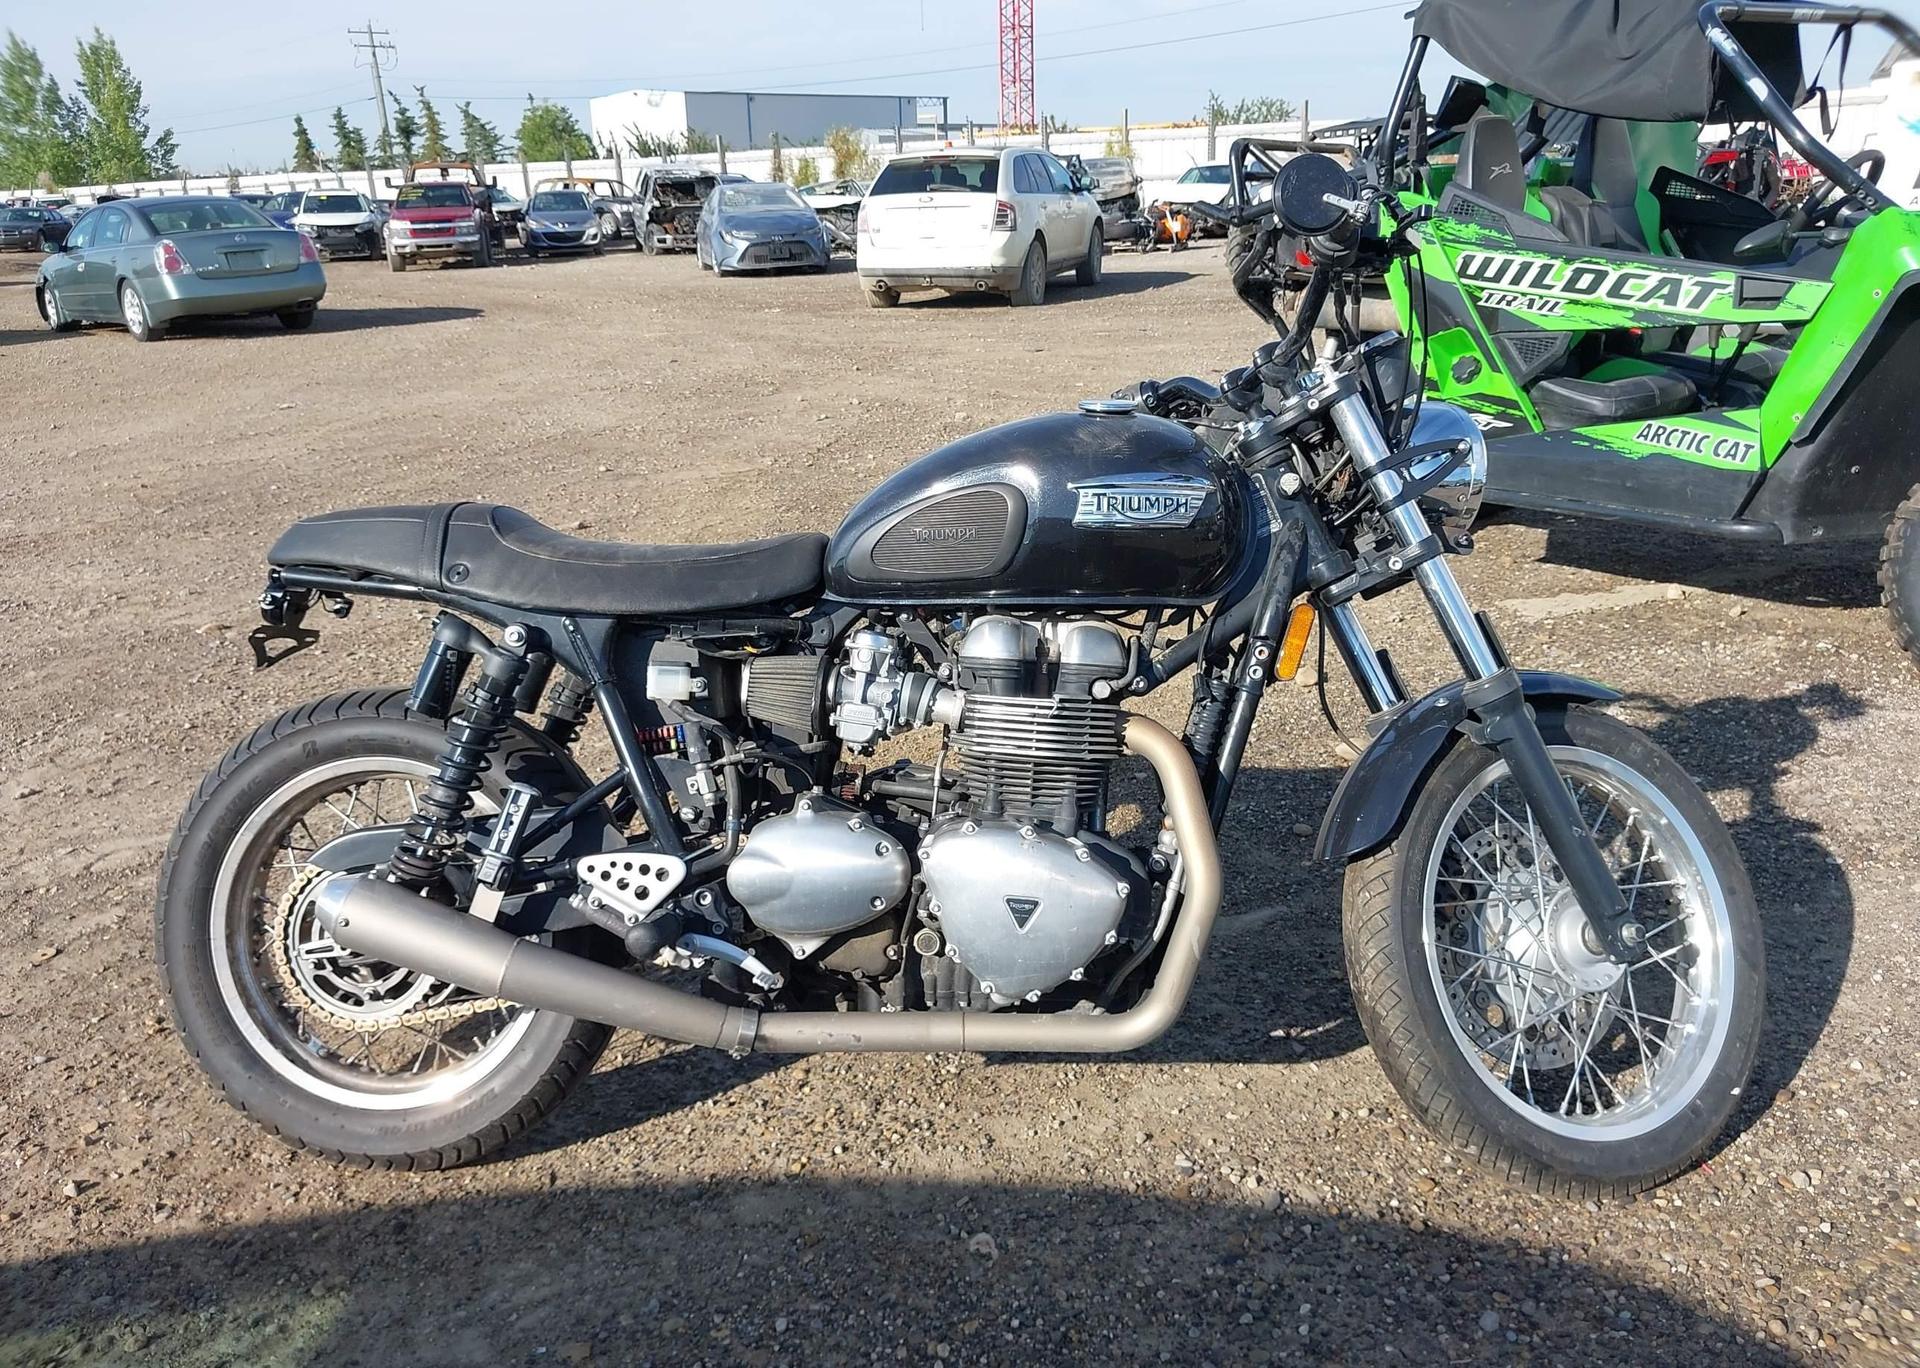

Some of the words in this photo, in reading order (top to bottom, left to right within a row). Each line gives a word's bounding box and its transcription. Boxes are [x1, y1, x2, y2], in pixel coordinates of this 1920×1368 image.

[1458, 253, 1731, 310] WILDCAT
[1483, 292, 1564, 314] TRAIL
[1636, 423, 1711, 453] ARCTIC
[1712, 438, 1755, 463] CAT
[1092, 492, 1190, 519] TRIUMPH
[913, 527, 977, 545] TRIUMPH
